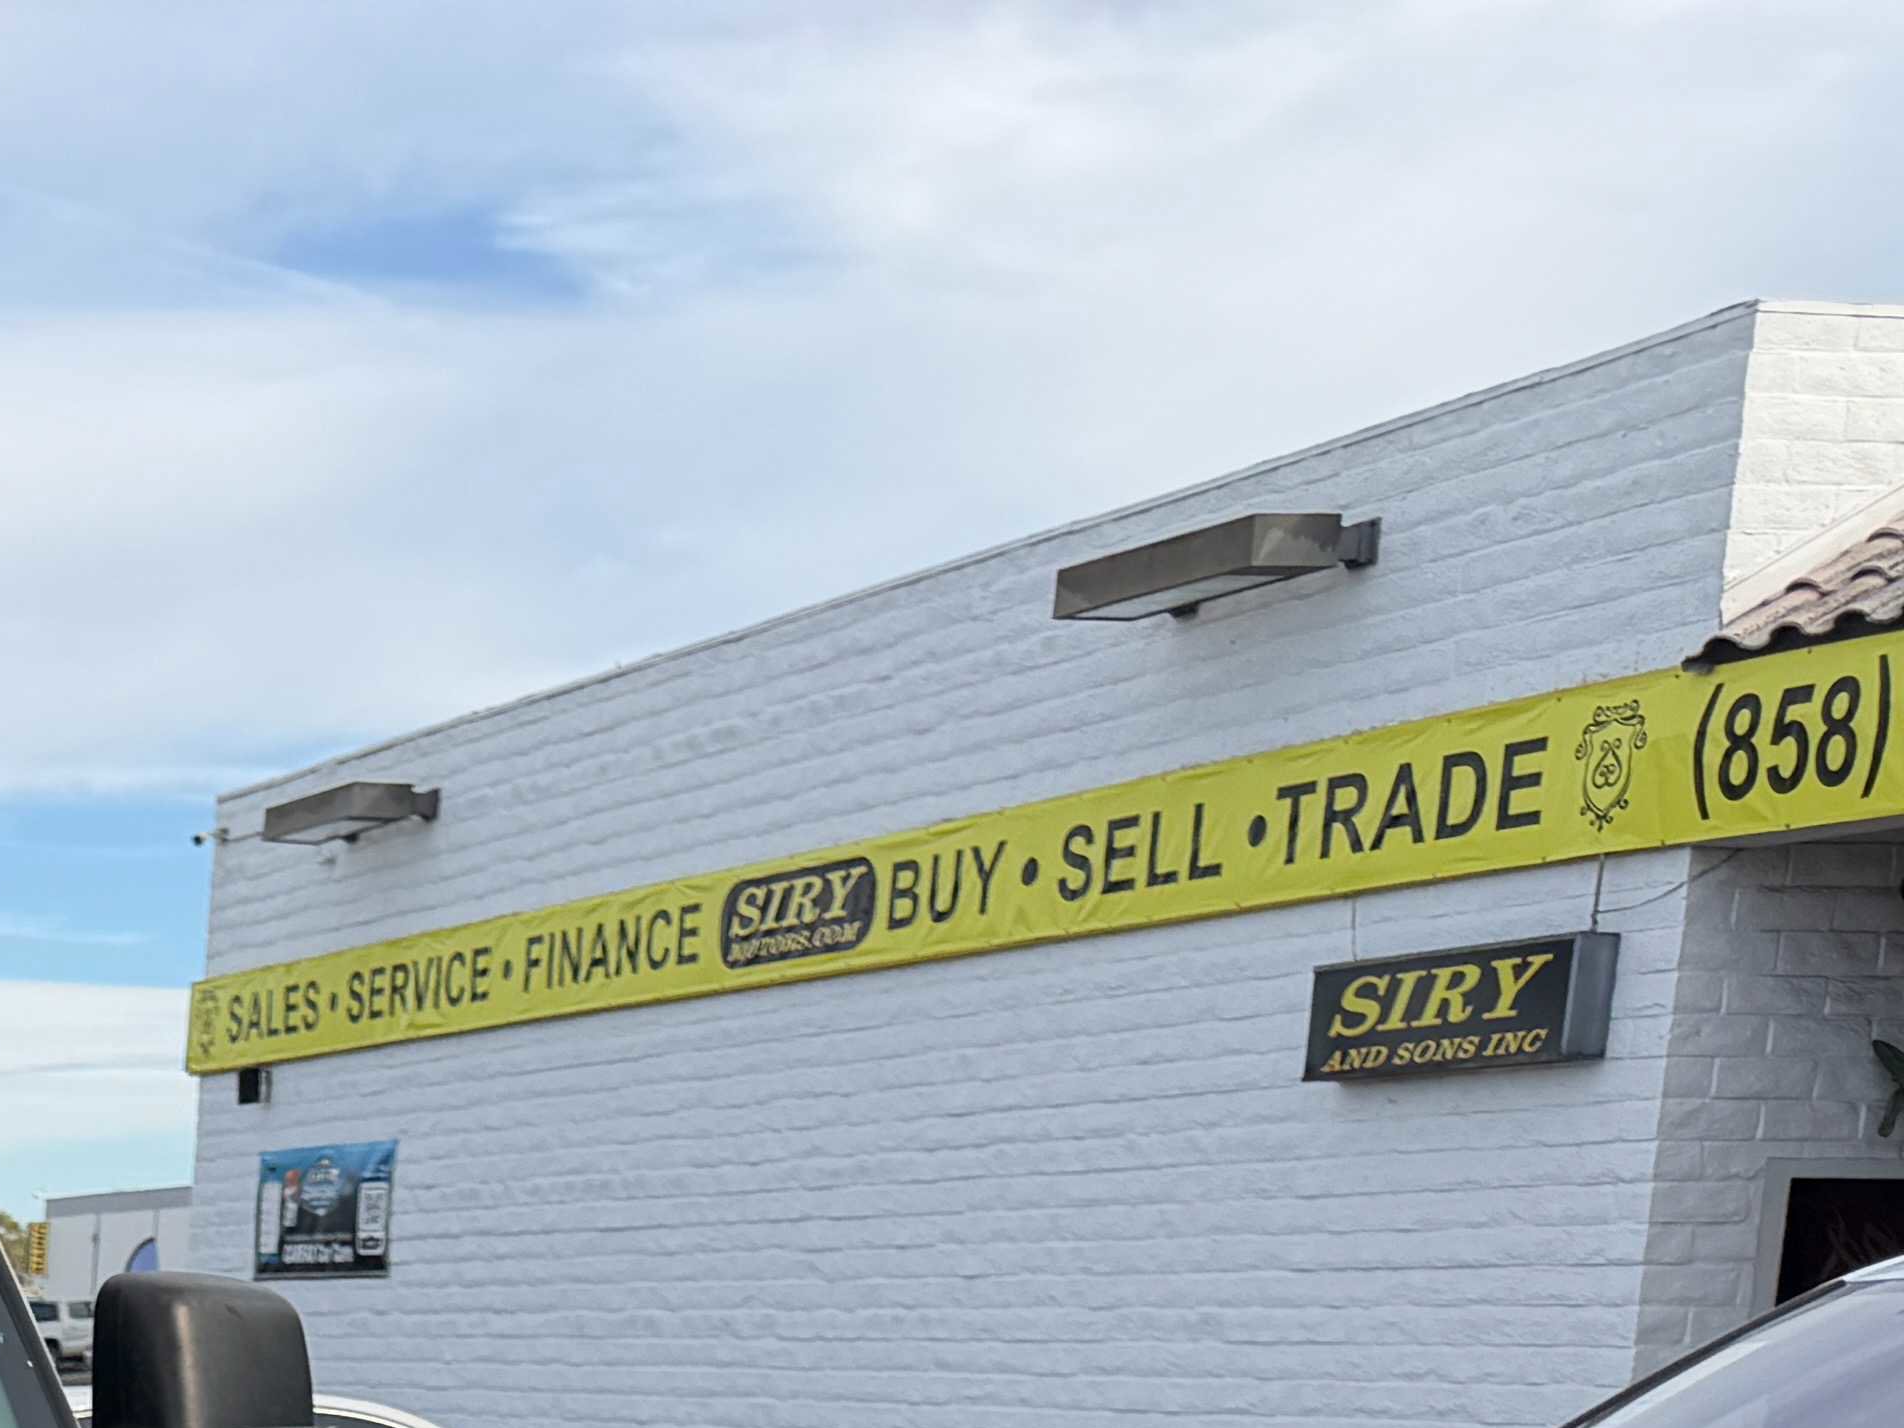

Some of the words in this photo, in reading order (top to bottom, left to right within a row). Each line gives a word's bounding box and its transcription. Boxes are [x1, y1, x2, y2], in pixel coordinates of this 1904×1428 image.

[226, 980, 321, 1044] SALES
[346, 946, 492, 1025] SERVICE
[523, 902, 703, 993] FINANCE
[729, 865, 870, 939] SIRY
[887, 839, 1008, 931] BUY
[1057, 801, 1223, 902] SELL
[1276, 735, 1549, 866] TRADE
[1692, 653, 1890, 821] (858)
[726, 920, 863, 963] MOTORS.COM
[1327, 953, 1555, 1038] SIRY
[1319, 1044, 1389, 1074] AND
[1392, 1035, 1480, 1066] SONS
[1482, 1028, 1549, 1057] INC
